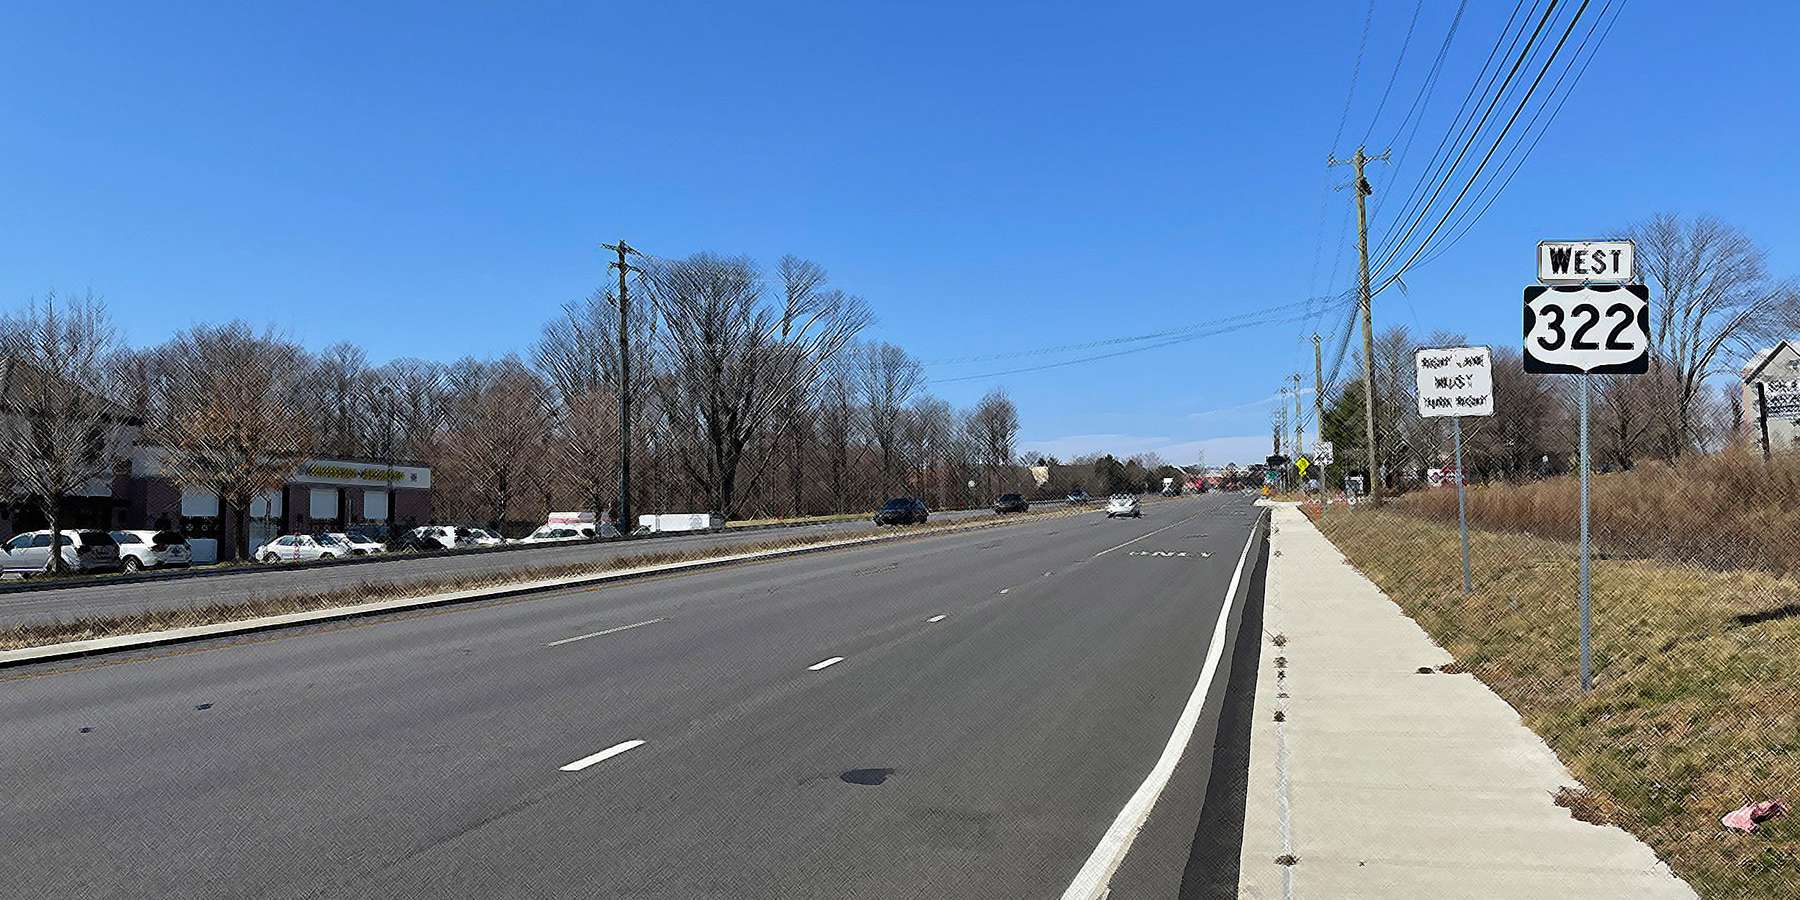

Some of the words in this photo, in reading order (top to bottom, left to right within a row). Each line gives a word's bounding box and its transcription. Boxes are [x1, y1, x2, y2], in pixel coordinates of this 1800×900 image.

[1549, 247, 1622, 275] WEST
[1537, 303, 1635, 351] 322
[1421, 355, 1452, 369] RIGHT
[1455, 354, 1484, 368] LANE
[1434, 374, 1473, 390] MUST
[1423, 395, 1452, 409] TURN
[1455, 395, 1488, 408] RIGHT
